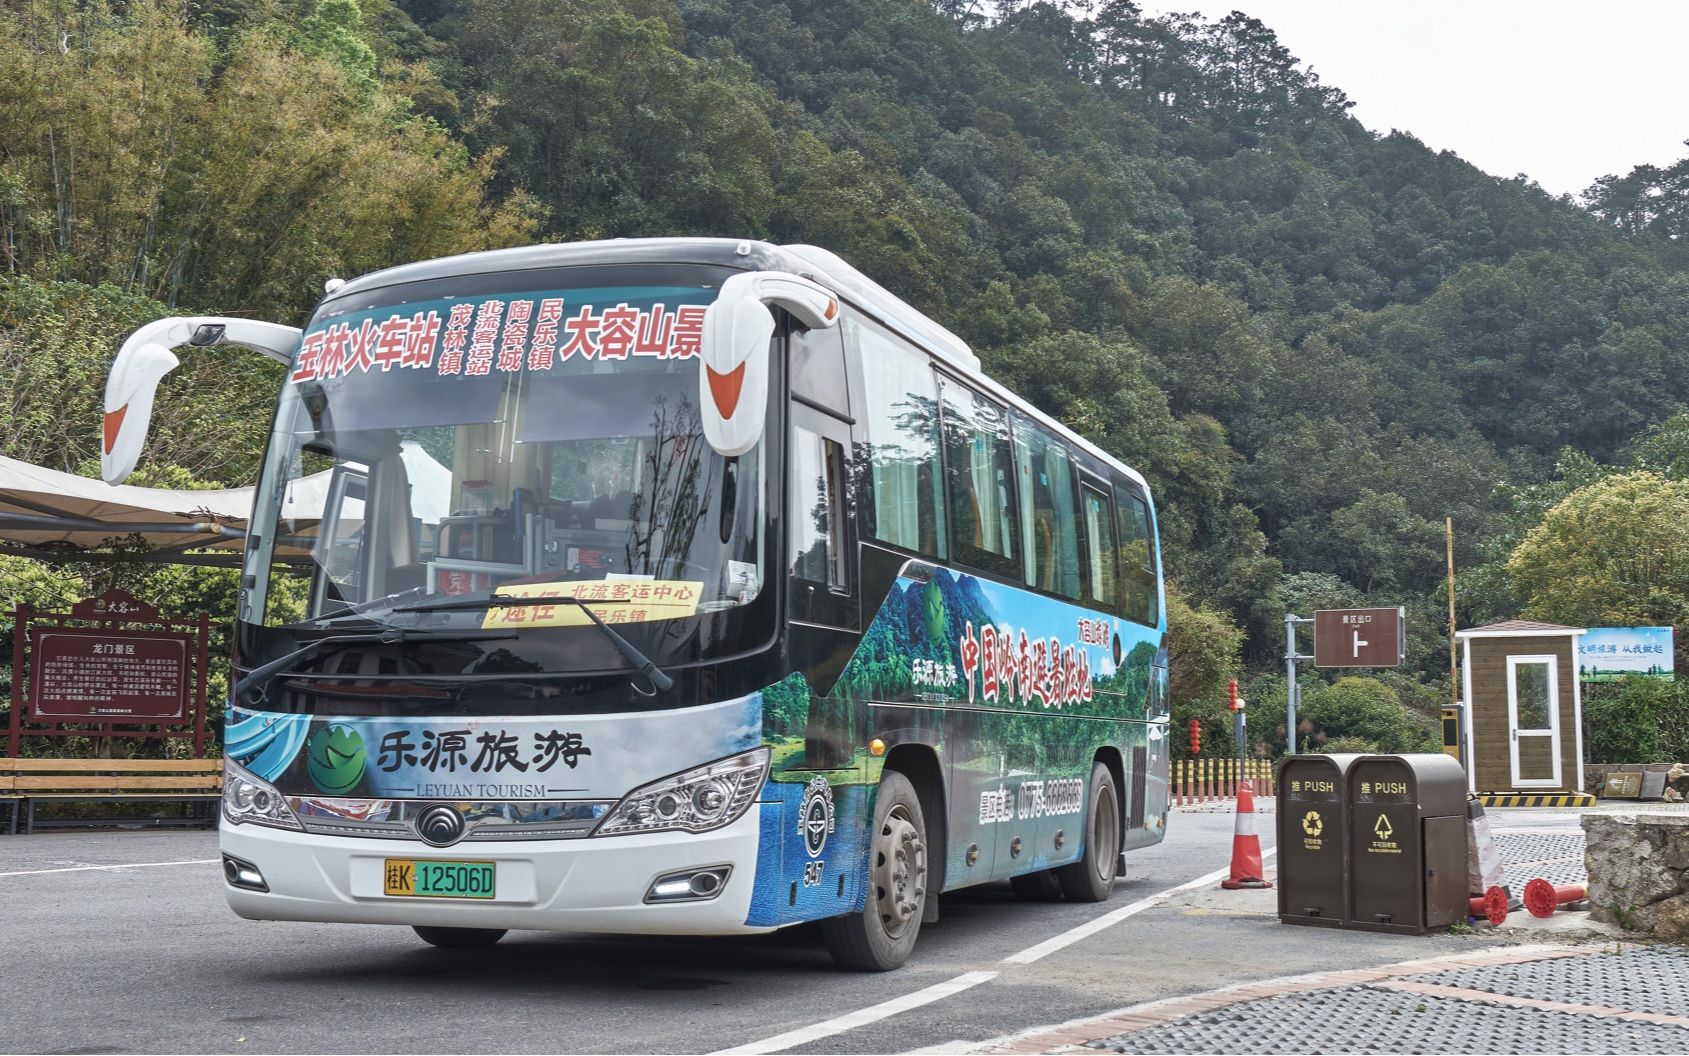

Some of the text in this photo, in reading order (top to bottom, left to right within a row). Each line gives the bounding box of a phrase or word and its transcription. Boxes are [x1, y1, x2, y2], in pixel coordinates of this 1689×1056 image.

[291, 312, 441, 383] 玉林火车站
[438, 304, 474, 375] 茂林镇
[465, 300, 505, 375] 北流客运站
[496, 300, 533, 371] 陶瓷城
[528, 298, 564, 371] 民乐镇
[571, 584, 693, 600] 北流客运中心
[1343, 615, 1371, 624] 景区出口
[92, 643, 135, 655] 龙门景区
[1578, 644, 1663, 654] 文明旅游 从我做起
[912, 658, 957, 687] 乐源旅游
[961, 621, 1092, 709] 中国岭南避暑胜地
[377, 729, 592, 772] 乐源旅游
[416, 784, 546, 797] LEYUAN TOURISM
[1291, 781, 1334, 792] 推 PUSH
[1361, 782, 1407, 793] 推 PUSH
[387, 865, 493, 893] 桂K 12506D
[803, 860, 825, 887] 547
